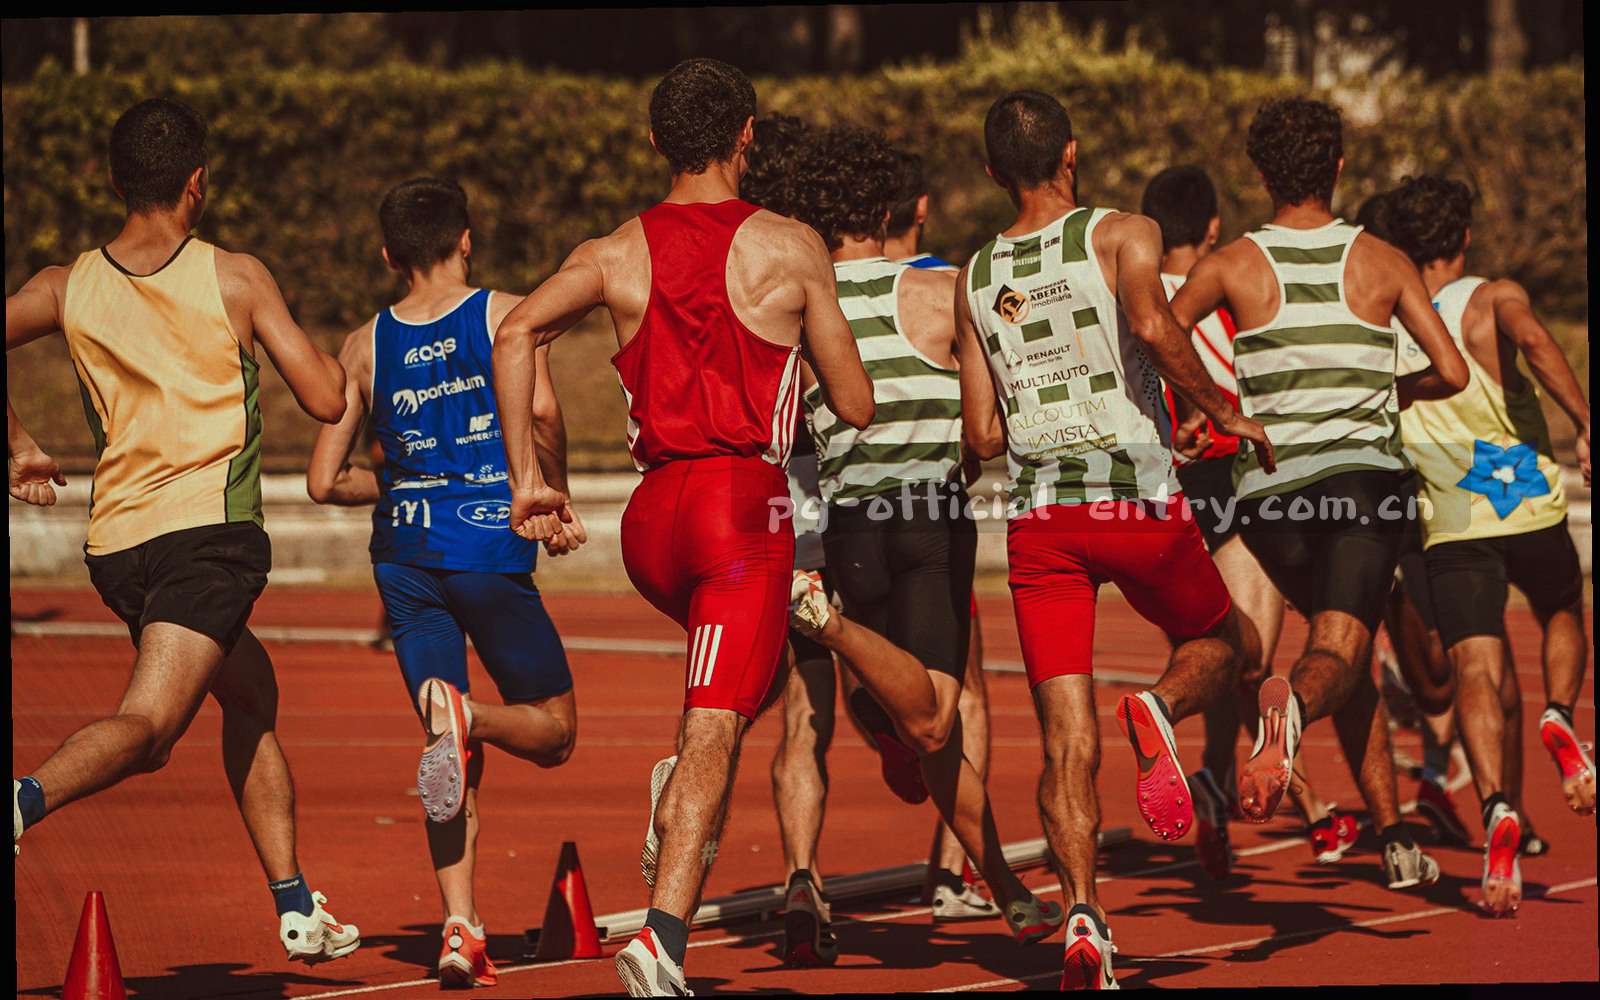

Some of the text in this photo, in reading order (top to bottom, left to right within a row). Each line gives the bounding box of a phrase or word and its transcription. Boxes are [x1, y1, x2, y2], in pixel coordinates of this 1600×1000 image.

[1030, 284, 1070, 301] ABERTA
[1027, 344, 1071, 362] RENAULT
[417, 375, 485, 405] portalum
[1010, 364, 1089, 393] MULTIAUTO
[1012, 397, 1107, 434] ALCOUTIM
[405, 437, 437, 456] group
